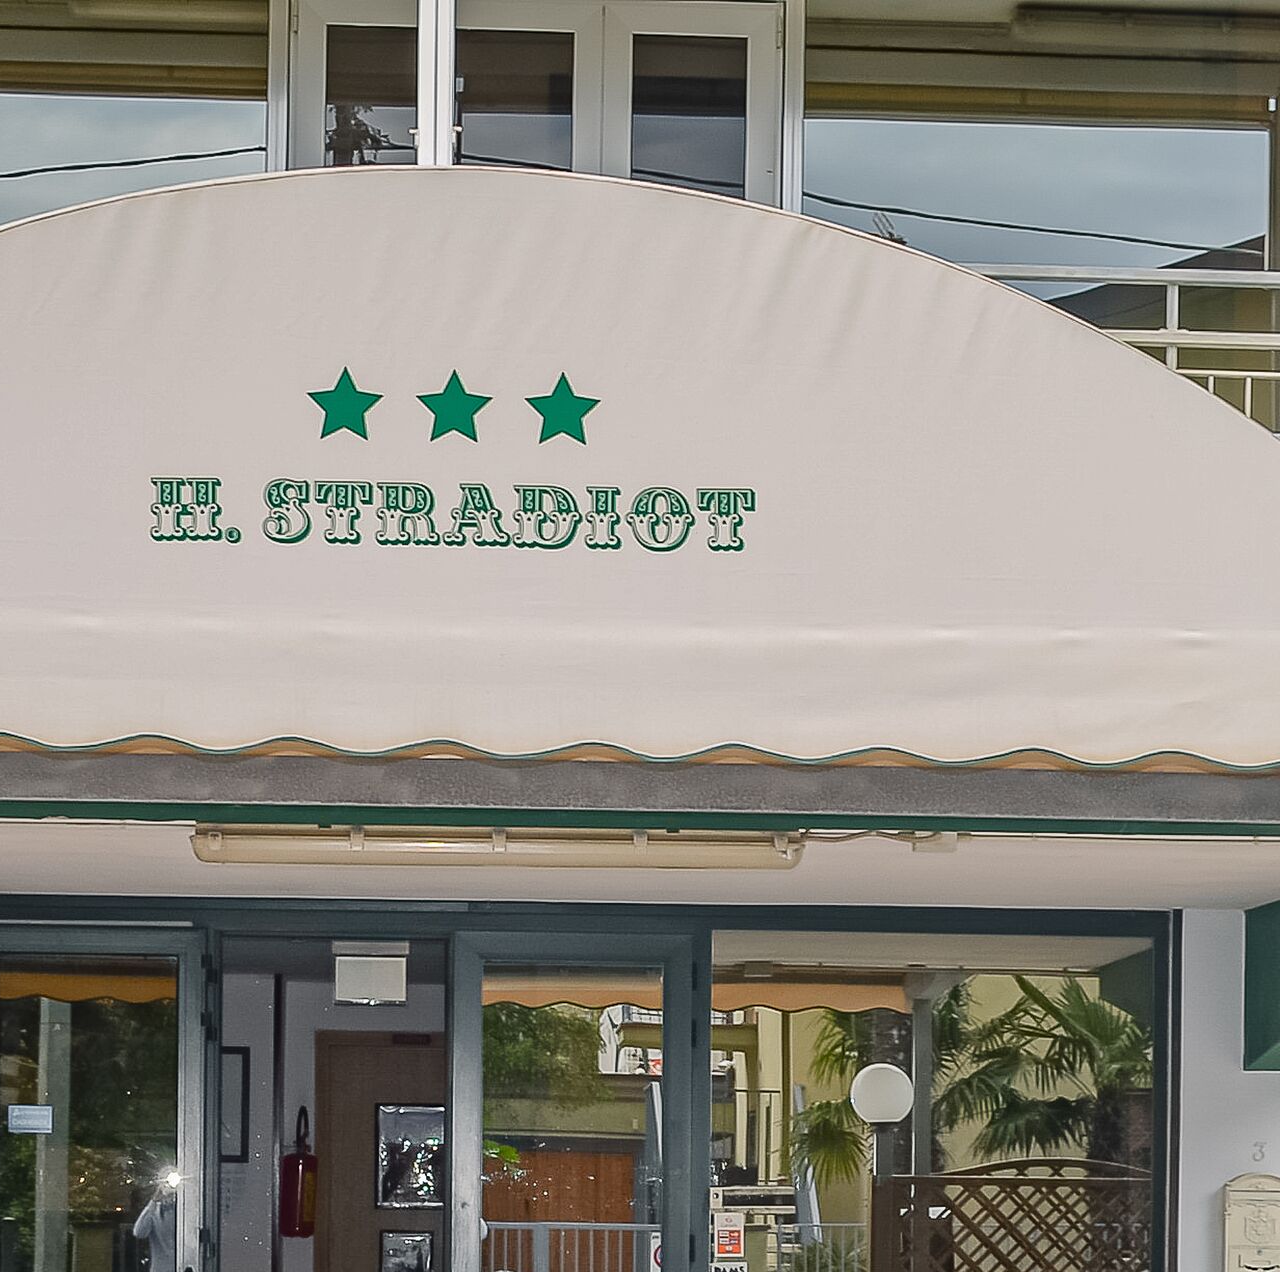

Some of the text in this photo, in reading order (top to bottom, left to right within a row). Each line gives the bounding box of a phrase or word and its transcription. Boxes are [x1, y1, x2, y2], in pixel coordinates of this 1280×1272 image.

[150, 476, 757, 552] H. STRADIOT
[1253, 1141, 1267, 1162] 3
